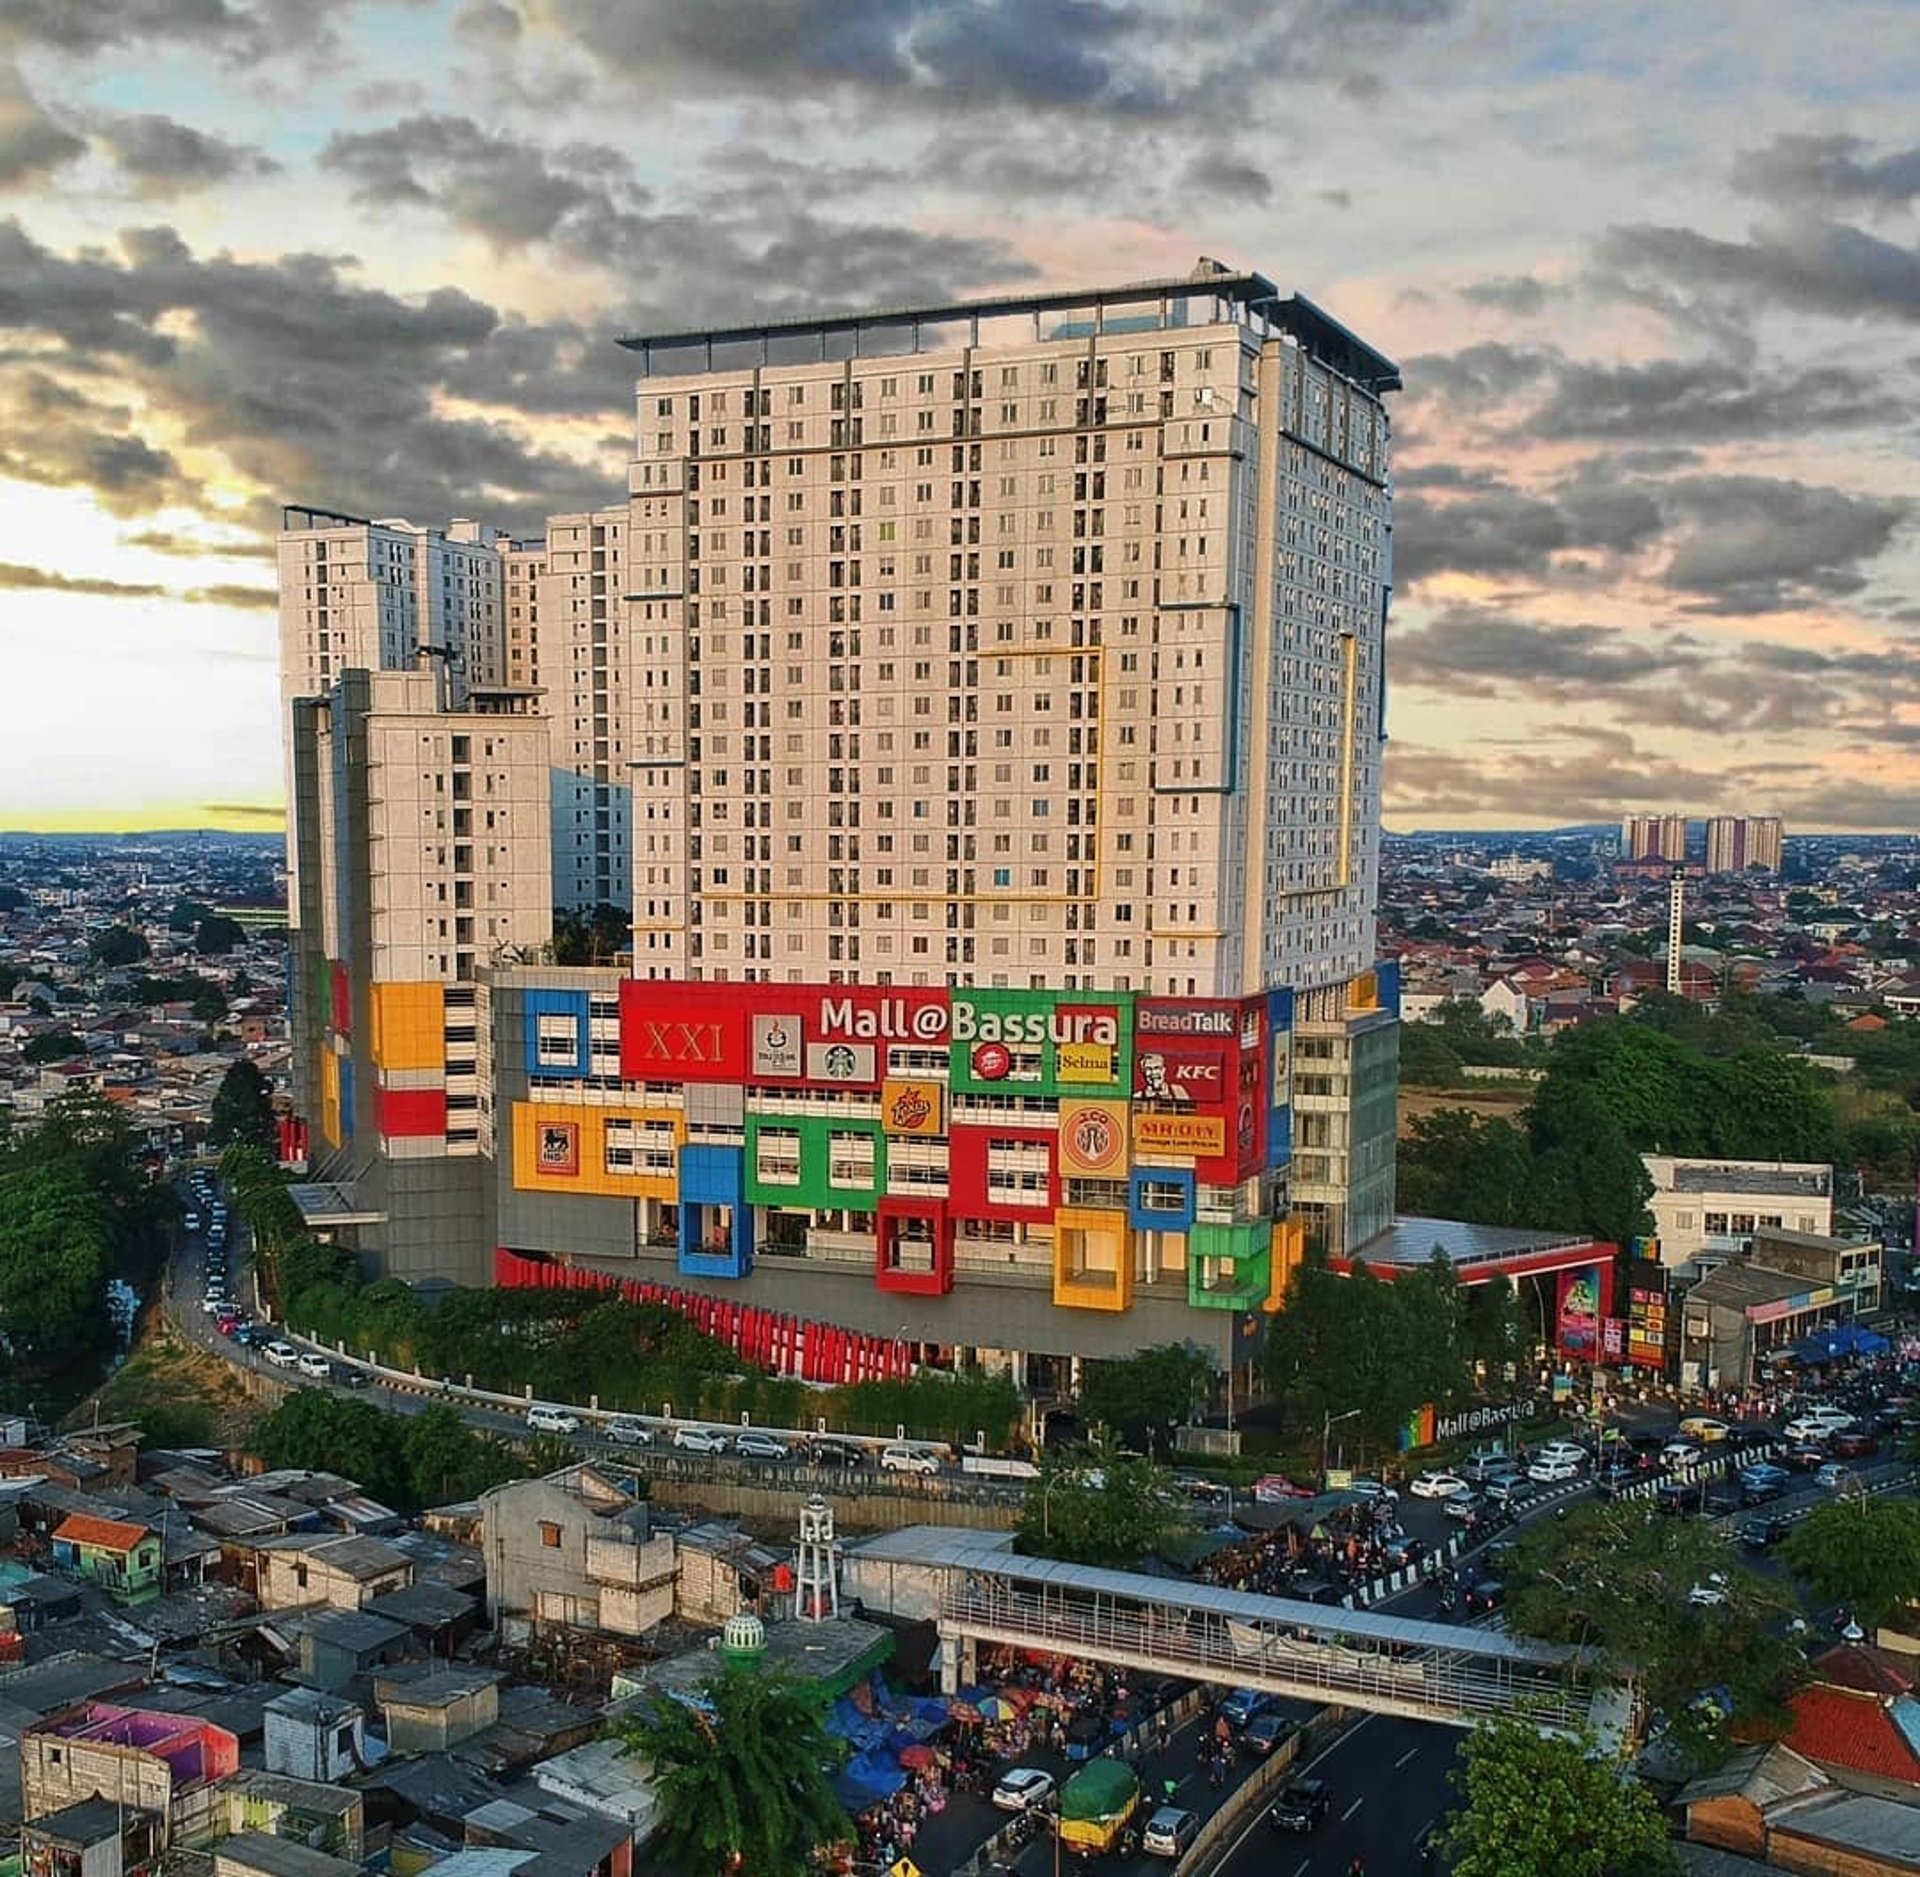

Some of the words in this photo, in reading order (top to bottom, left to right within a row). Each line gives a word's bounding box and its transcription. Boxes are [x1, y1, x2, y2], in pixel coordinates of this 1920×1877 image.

[820, 997, 1118, 1045] Mall@Bassura
[1138, 1009, 1233, 1033] BreadTalk
[643, 1021, 725, 1063] XXI
[1062, 1054, 1109, 1070] Selma
[1175, 1064, 1220, 1081] KFC
